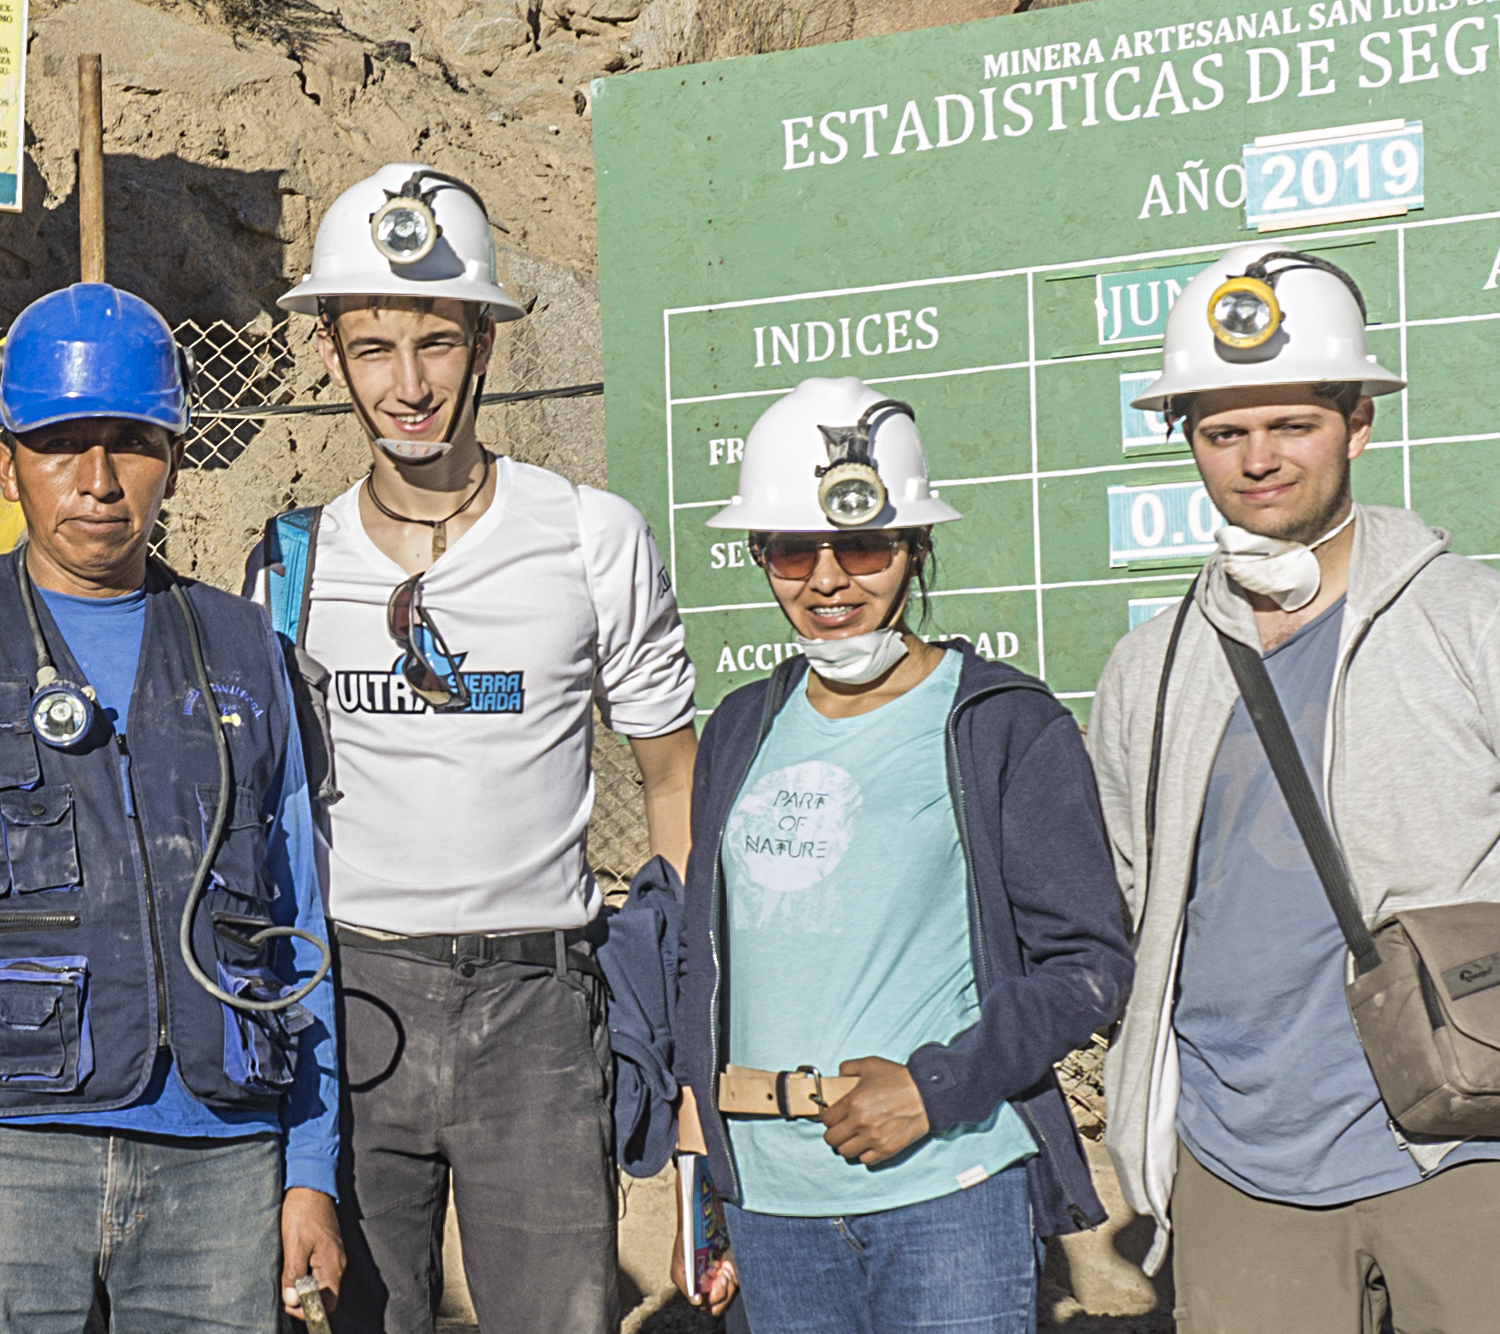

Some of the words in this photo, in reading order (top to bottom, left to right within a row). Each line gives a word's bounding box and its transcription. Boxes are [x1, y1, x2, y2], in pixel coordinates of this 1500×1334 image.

[983, 37, 1105, 80] MINERA
[1110, 6, 1302, 61] ARTESANAL
[781, 51, 1225, 171] ESTADISTICAS
[1246, 38, 1336, 105] DE
[1138, 158, 1246, 220] AÑO
[1260, 140, 1419, 212] 2019
[753, 305, 941, 369] INDICES
[1130, 489, 1224, 547] 0.0
[773, 789, 830, 808] PART
[778, 813, 806, 833] OF
[745, 834, 828, 859] NATURE
